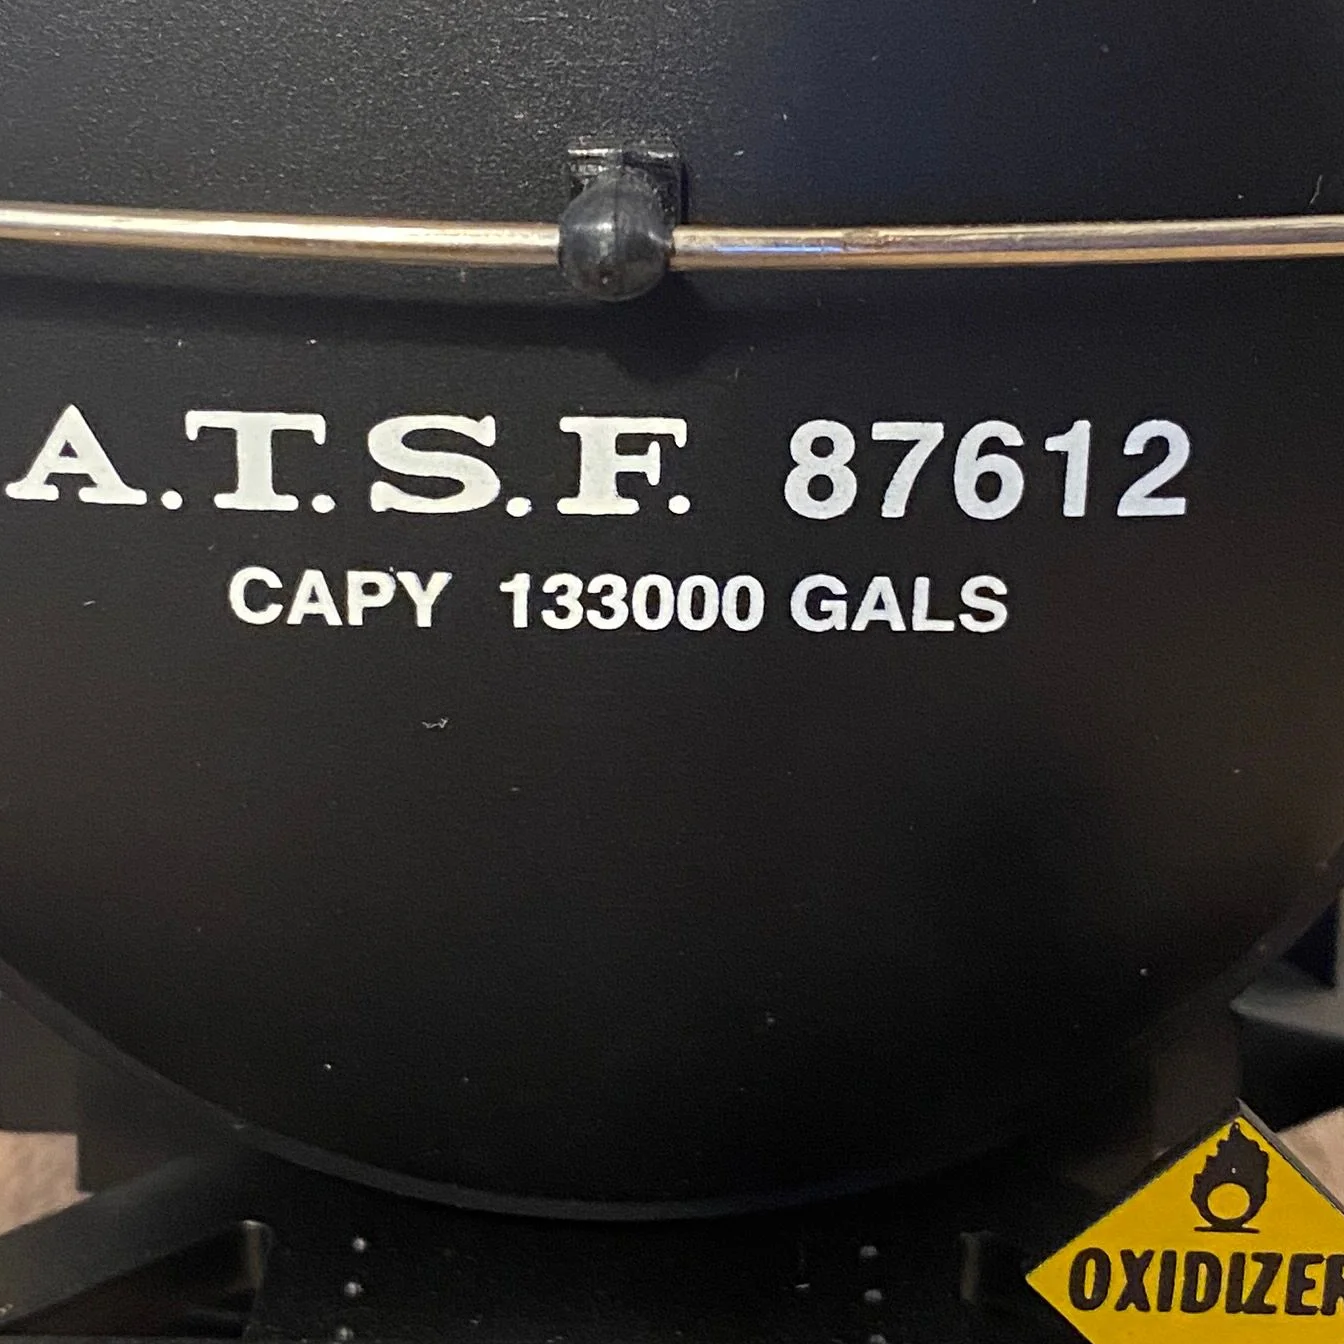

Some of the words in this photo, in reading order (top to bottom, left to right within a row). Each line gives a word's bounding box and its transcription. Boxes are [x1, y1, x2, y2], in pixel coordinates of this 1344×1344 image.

[4, 403, 691, 518] A.T.S.F.
[784, 419, 1190, 520] 87612
[228, 566, 453, 628] CAPY
[499, 572, 765, 632] 133000
[790, 573, 1008, 633] GALS
